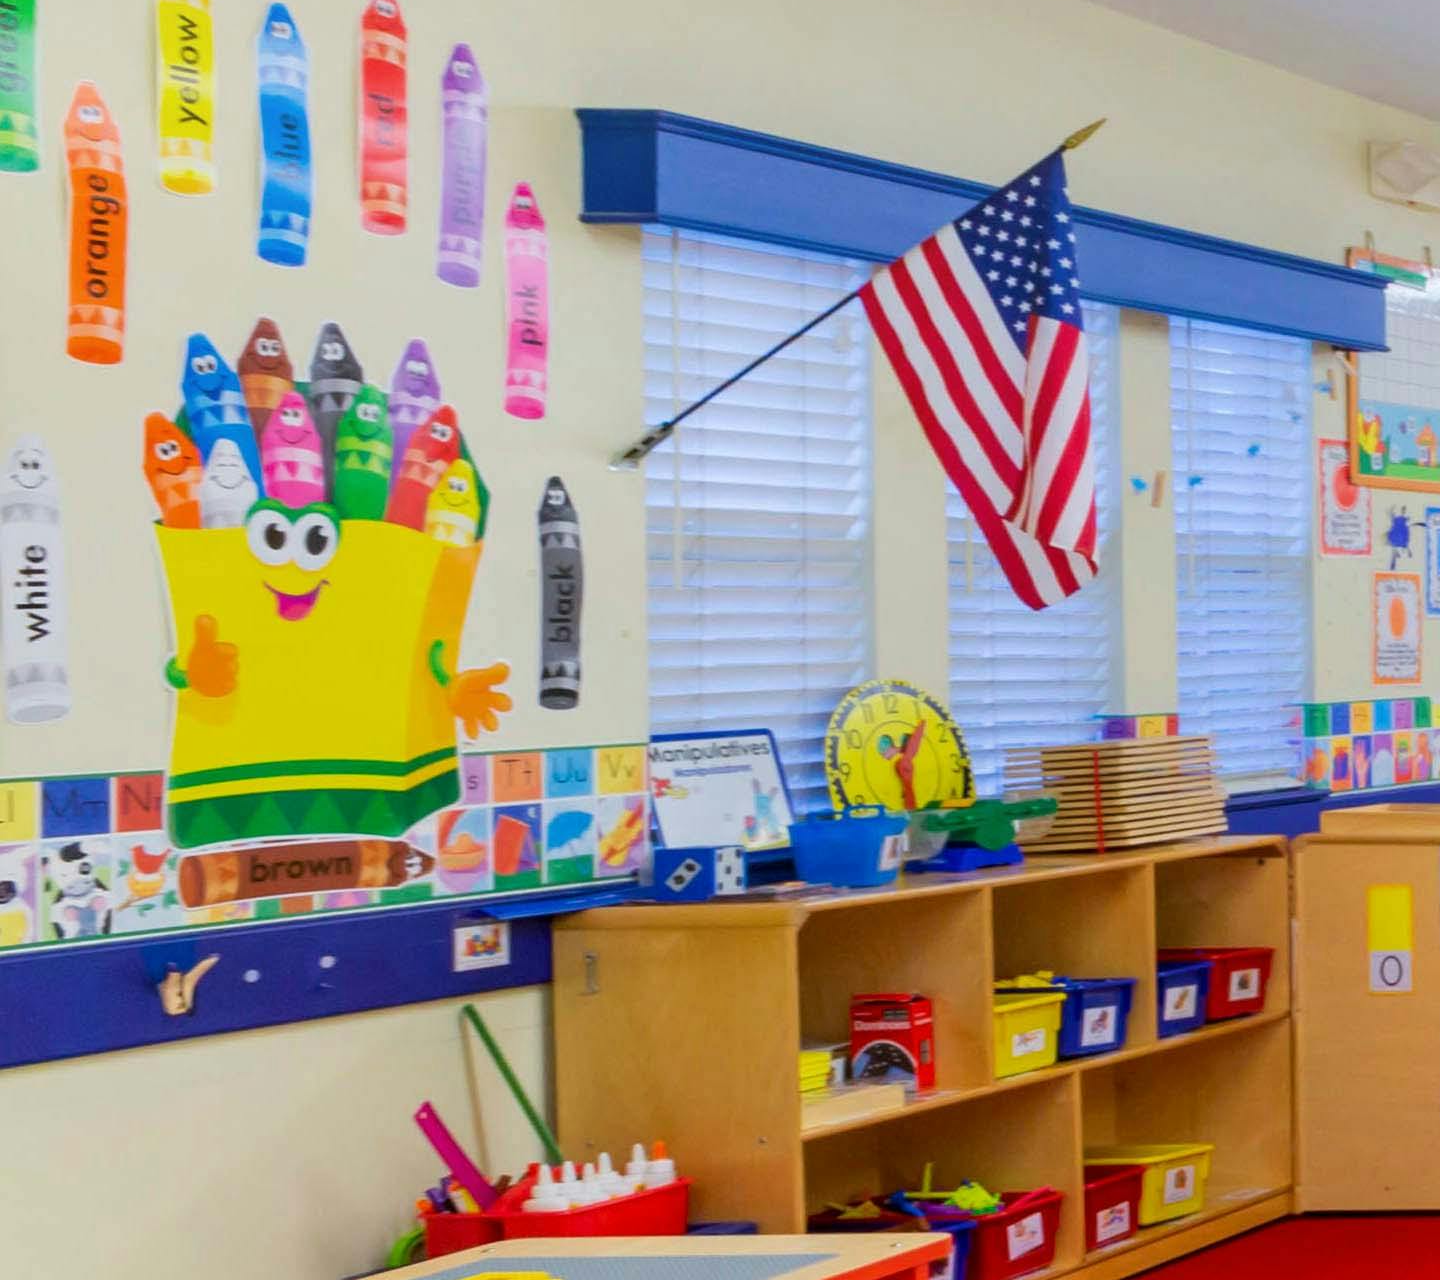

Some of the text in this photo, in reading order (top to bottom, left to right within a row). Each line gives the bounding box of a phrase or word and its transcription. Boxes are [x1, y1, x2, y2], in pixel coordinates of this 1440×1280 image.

[169, 15, 208, 127] yellow
[369, 93, 395, 147] red
[273, 113, 304, 180] blue
[86, 174, 121, 298] orange
[514, 285, 543, 347] pink
[14, 545, 51, 642] white
[548, 565, 575, 642] black
[649, 740, 770, 765] Manipulatives
[937, 723, 948, 743] 2
[499, 759, 533, 790] Tt
[552, 756, 587, 783] Uu
[606, 753, 636, 778] Vv
[250, 854, 352, 883] brown
[1380, 955, 1403, 987] 0
